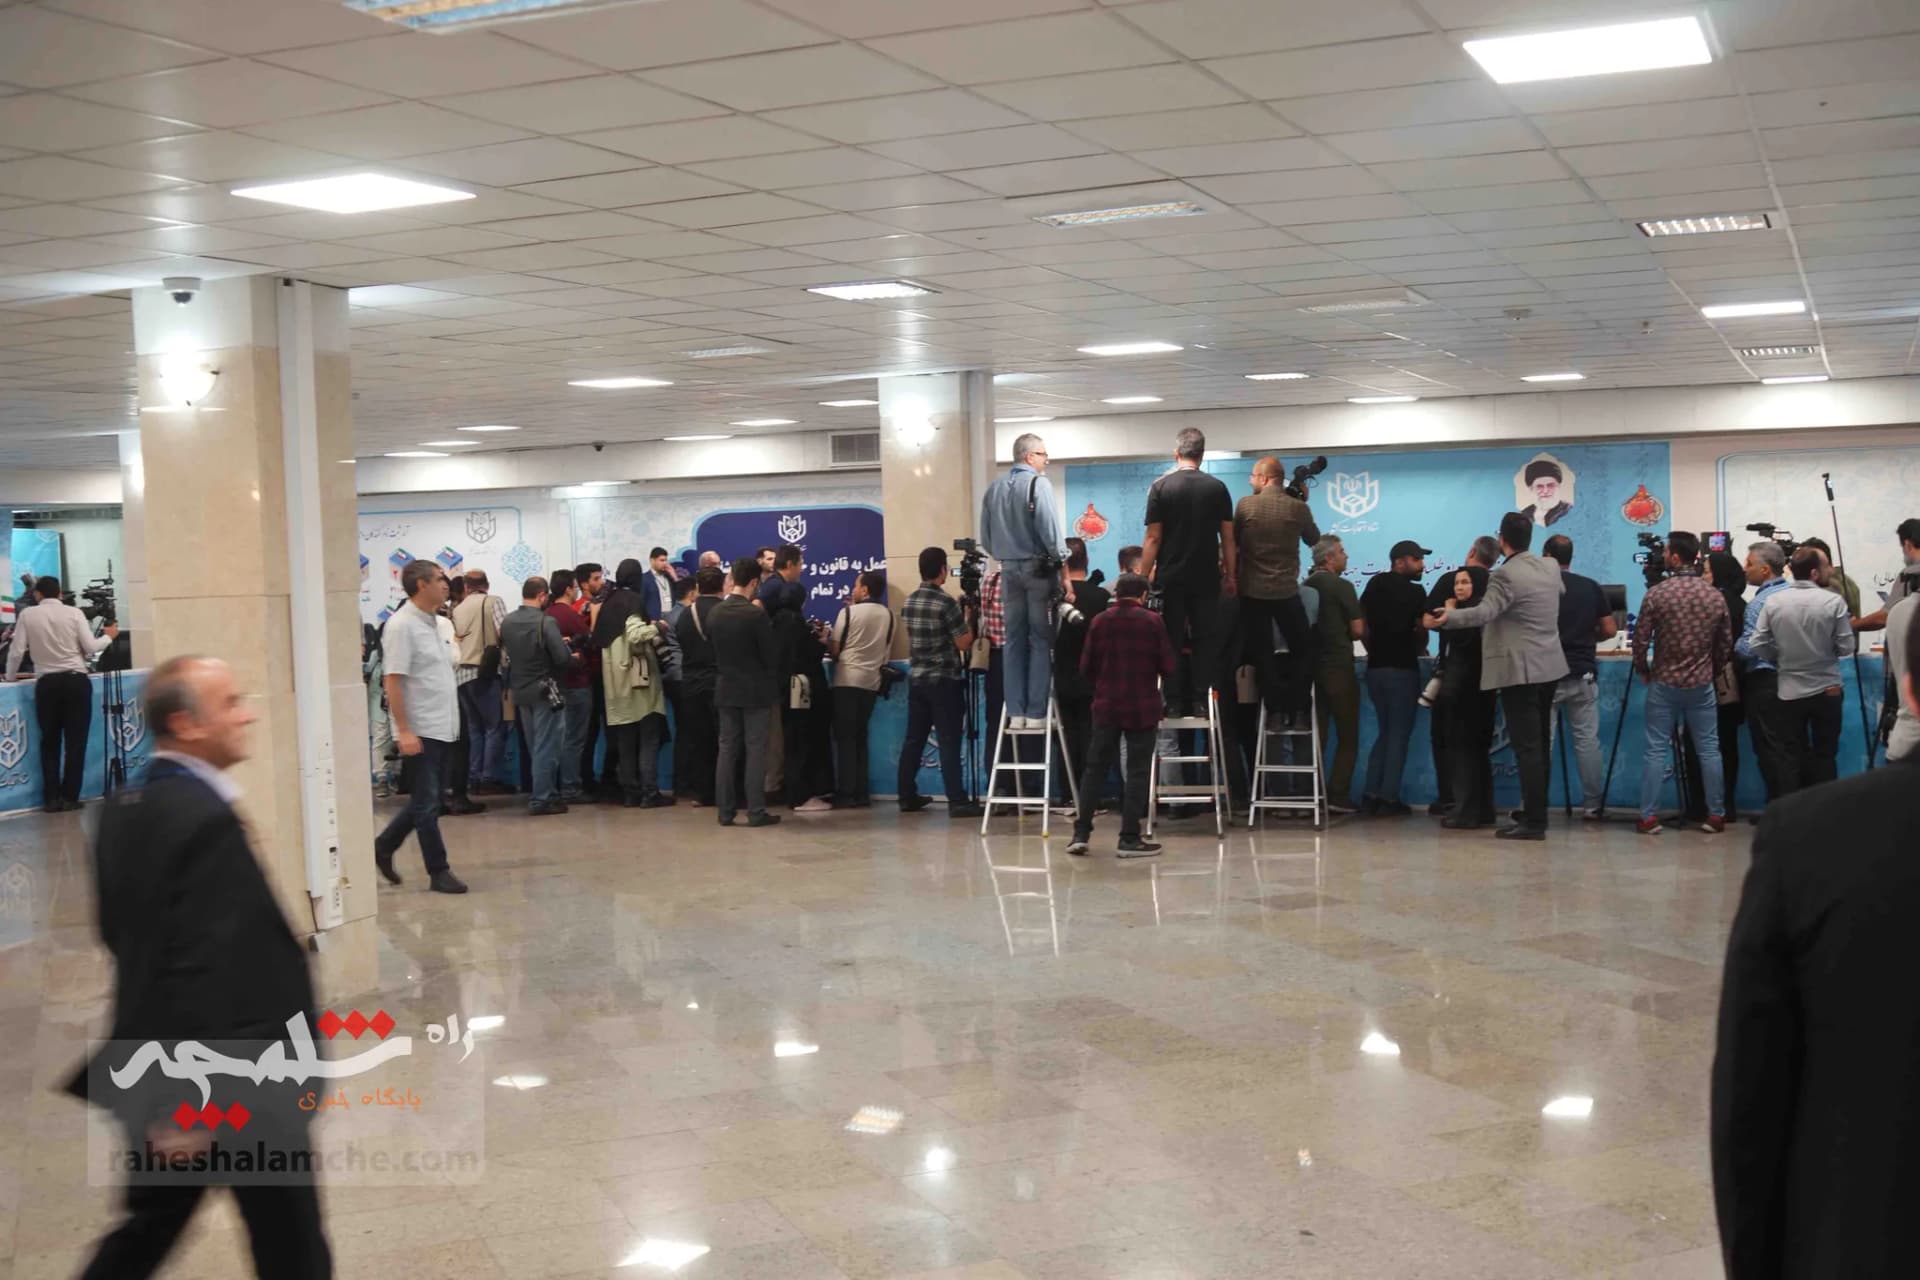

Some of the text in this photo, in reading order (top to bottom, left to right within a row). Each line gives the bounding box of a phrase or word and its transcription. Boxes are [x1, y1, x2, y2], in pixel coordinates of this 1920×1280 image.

[809, 563, 817, 576] و
[819, 557, 848, 575] قانون
[851, 560, 862, 573] به
[864, 556, 887, 572] عمل
[811, 582, 850, 600] در تمام
